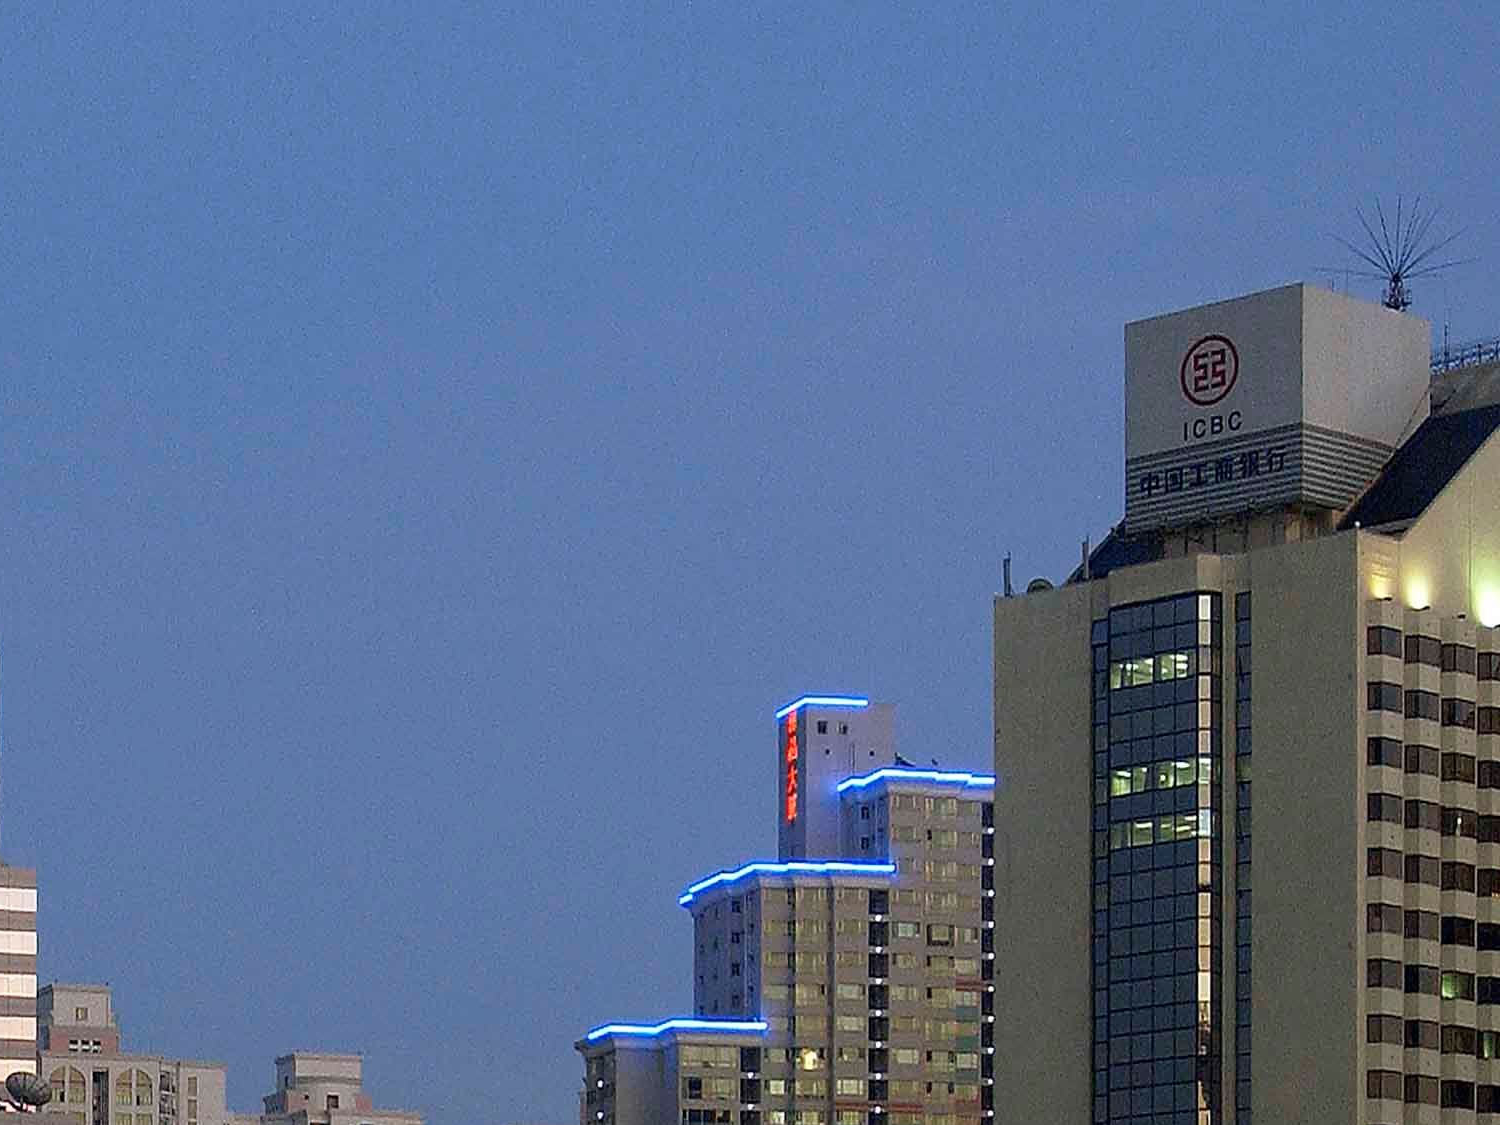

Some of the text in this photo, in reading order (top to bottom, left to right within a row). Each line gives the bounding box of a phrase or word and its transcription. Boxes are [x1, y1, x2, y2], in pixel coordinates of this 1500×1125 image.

[1183, 411, 1243, 441] ICBC
[1140, 448, 1287, 496] 中国工商银行
